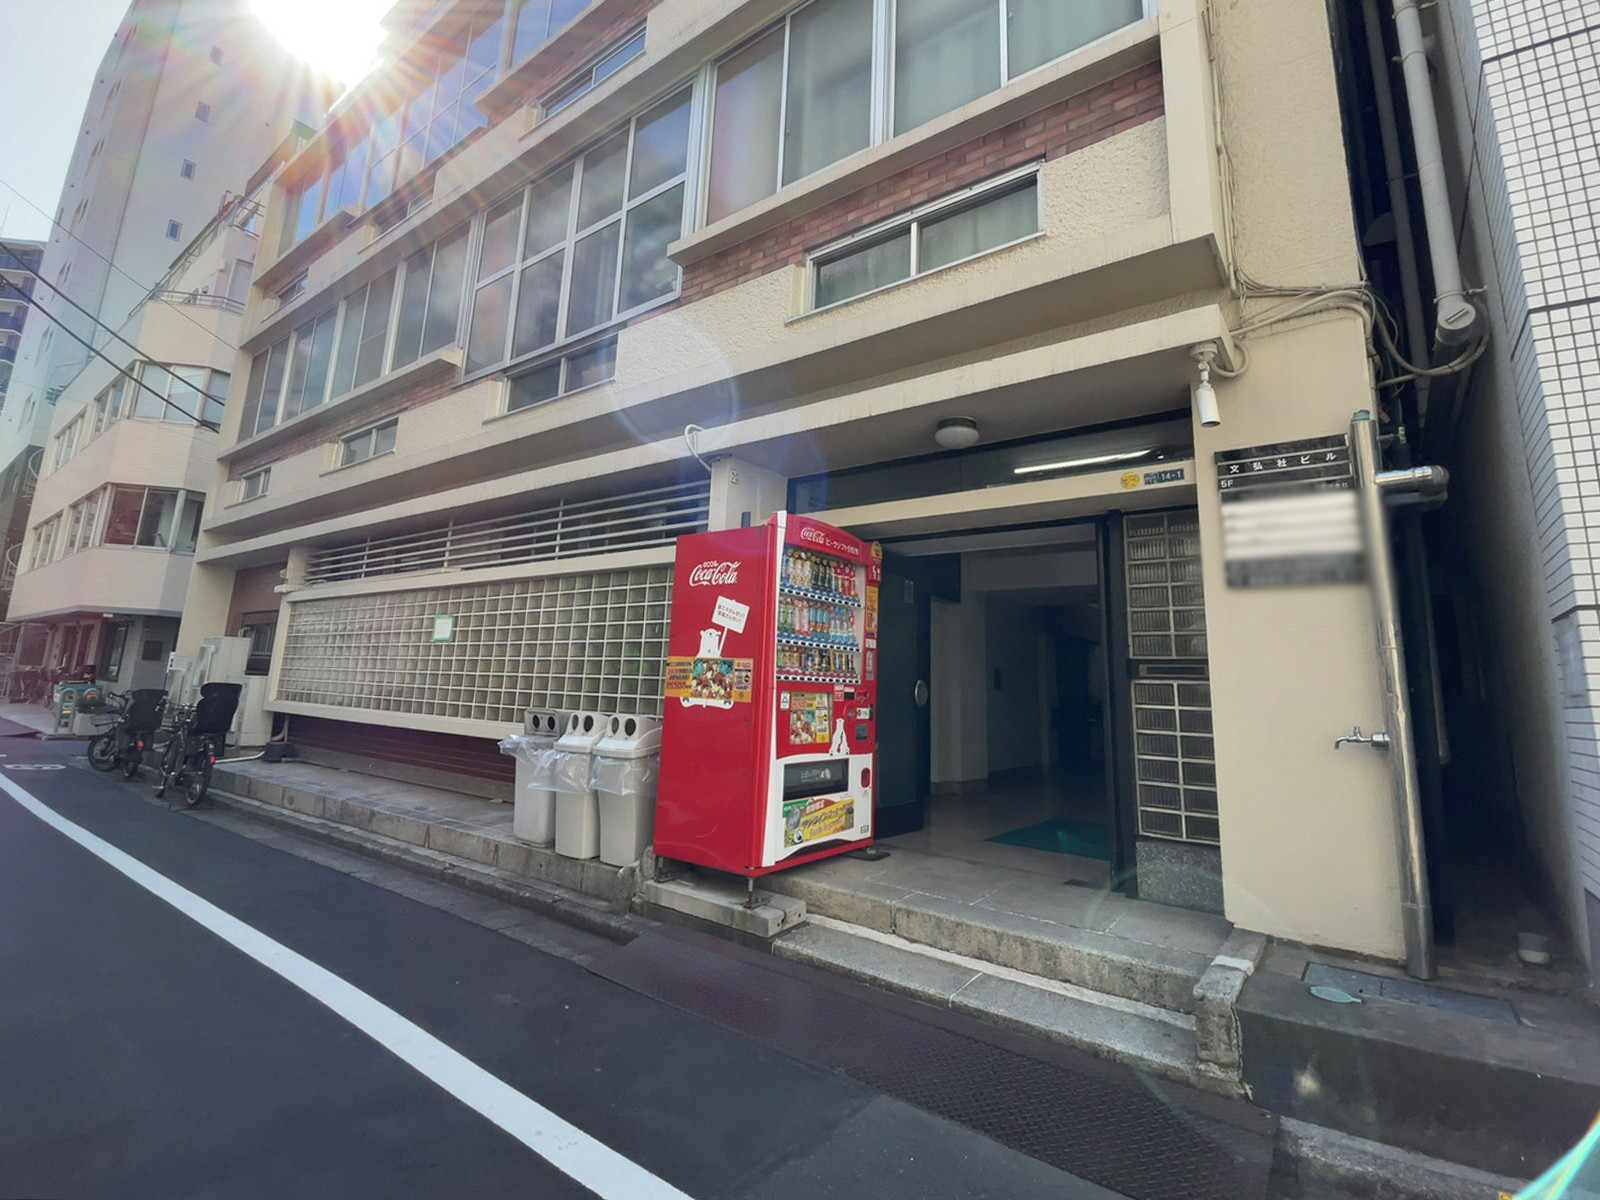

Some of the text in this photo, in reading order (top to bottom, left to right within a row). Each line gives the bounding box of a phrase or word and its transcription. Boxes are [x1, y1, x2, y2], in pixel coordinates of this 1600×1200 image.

[1230, 452, 1336, 474] 文弘社ビル
[1161, 471, 1181, 481] 14-1
[1220, 479, 1234, 488] 5F
[800, 527, 825, 544] Coca-Cola
[689, 561, 742, 587] Coca-Cola
